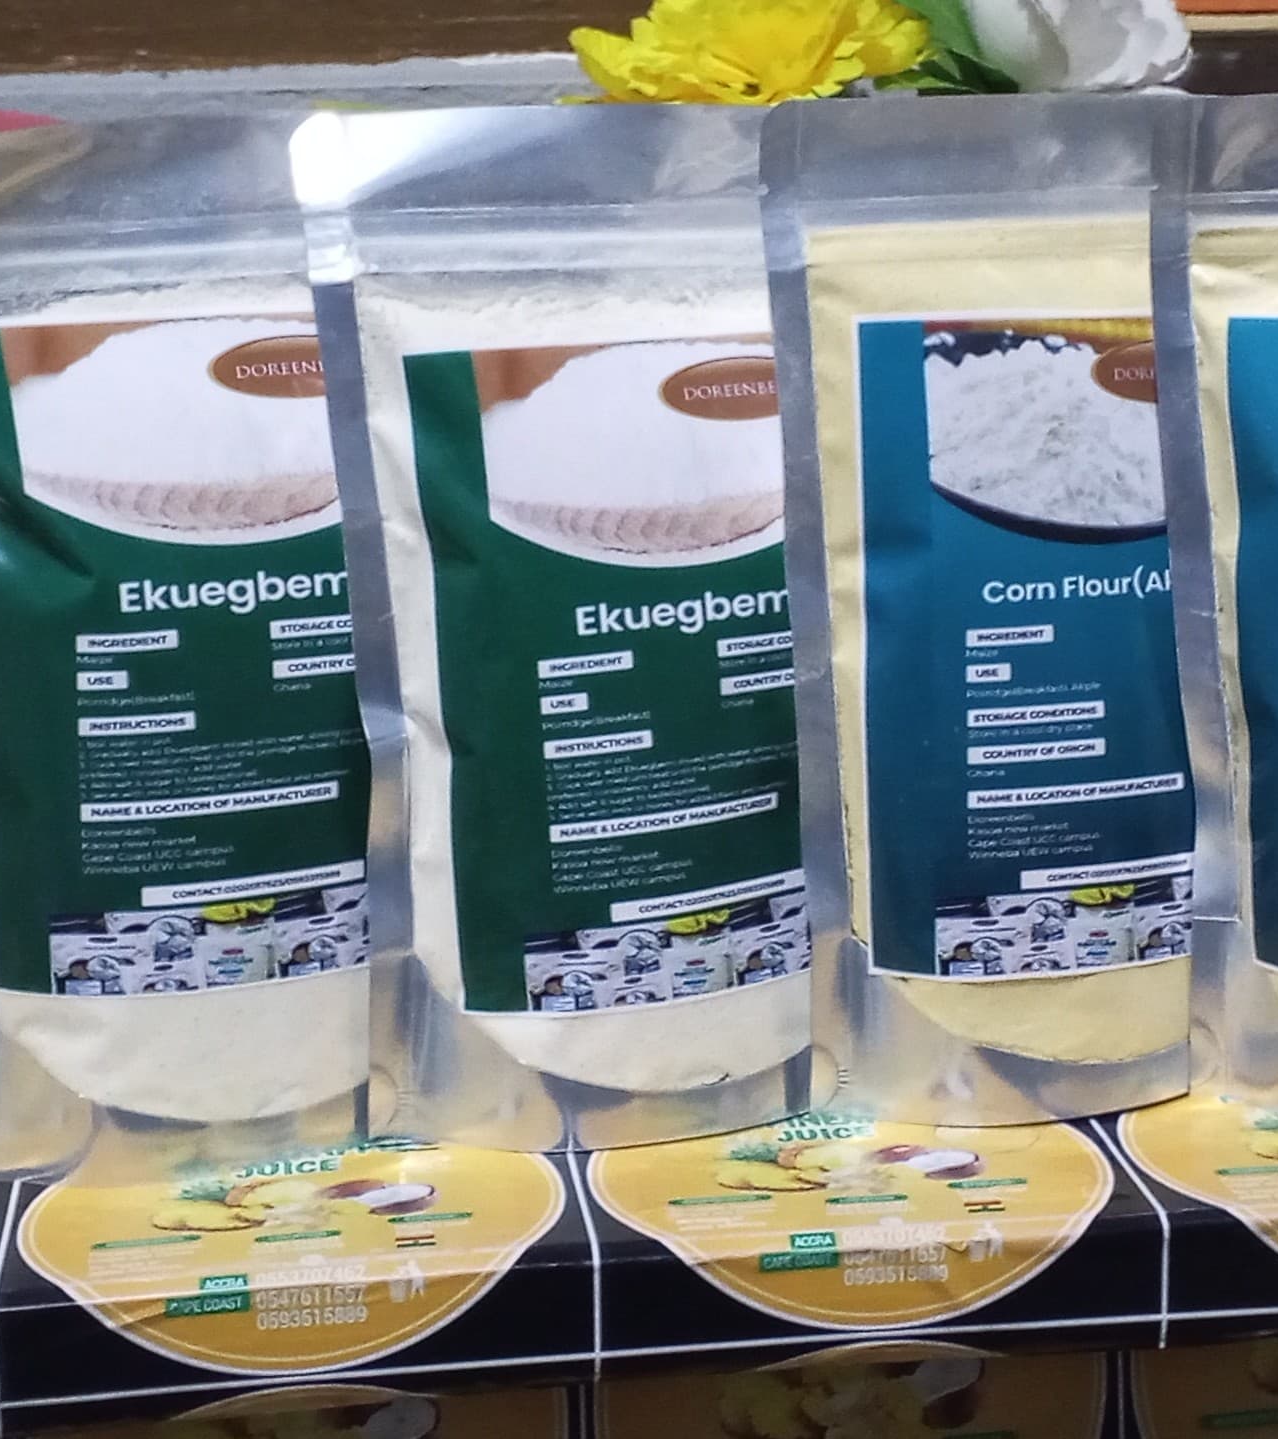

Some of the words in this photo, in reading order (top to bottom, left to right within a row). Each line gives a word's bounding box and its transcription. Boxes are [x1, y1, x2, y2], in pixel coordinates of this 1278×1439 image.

[683, 380, 777, 401] DOREENBE
[982, 581, 1055, 603] Corn
[280, 620, 334, 633] STORAGE
[88, 635, 167, 648] INGREDIENT
[977, 630, 1045, 642] INGREDIENT
[727, 638, 773, 652] STORAGE
[288, 659, 344, 672] COUNTRY
[550, 656, 622, 672] INGREDIENT
[976, 668, 999, 678] USE
[88, 676, 113, 686] USE
[734, 674, 781, 689] COUNTRY
[551, 698, 575, 709] USE
[974, 710, 1027, 723] STORAGE
[1030, 706, 1097, 719] CONDITIONS
[90, 718, 186, 732] INSTRUCTIONS
[555, 735, 644, 753] INSTRUCTIONS
[983, 747, 1038, 759] COUNTRY
[1040, 746, 1054, 755] OF
[1057, 743, 1095, 754] ORIGIN
[977, 794, 1014, 804] NAME
[1025, 788, 1080, 801] LOCATION
[1084, 787, 1096, 796] OF
[1099, 778, 1178, 795] MANUFACTURER
[91, 805, 132, 817] NAME
[146, 799, 211, 815] LOCATION
[214, 798, 230, 808] OF
[233, 786, 332, 807] MANUFACTURER
[560, 825, 598, 838] NAME
[611, 816, 670, 833] LOCATION
[673, 813, 687, 824] OF
[689, 798, 773, 821] MANUFACTURER
[237, 1158, 339, 1178] JUICE
[204, 1297, 243, 1312] COAST
